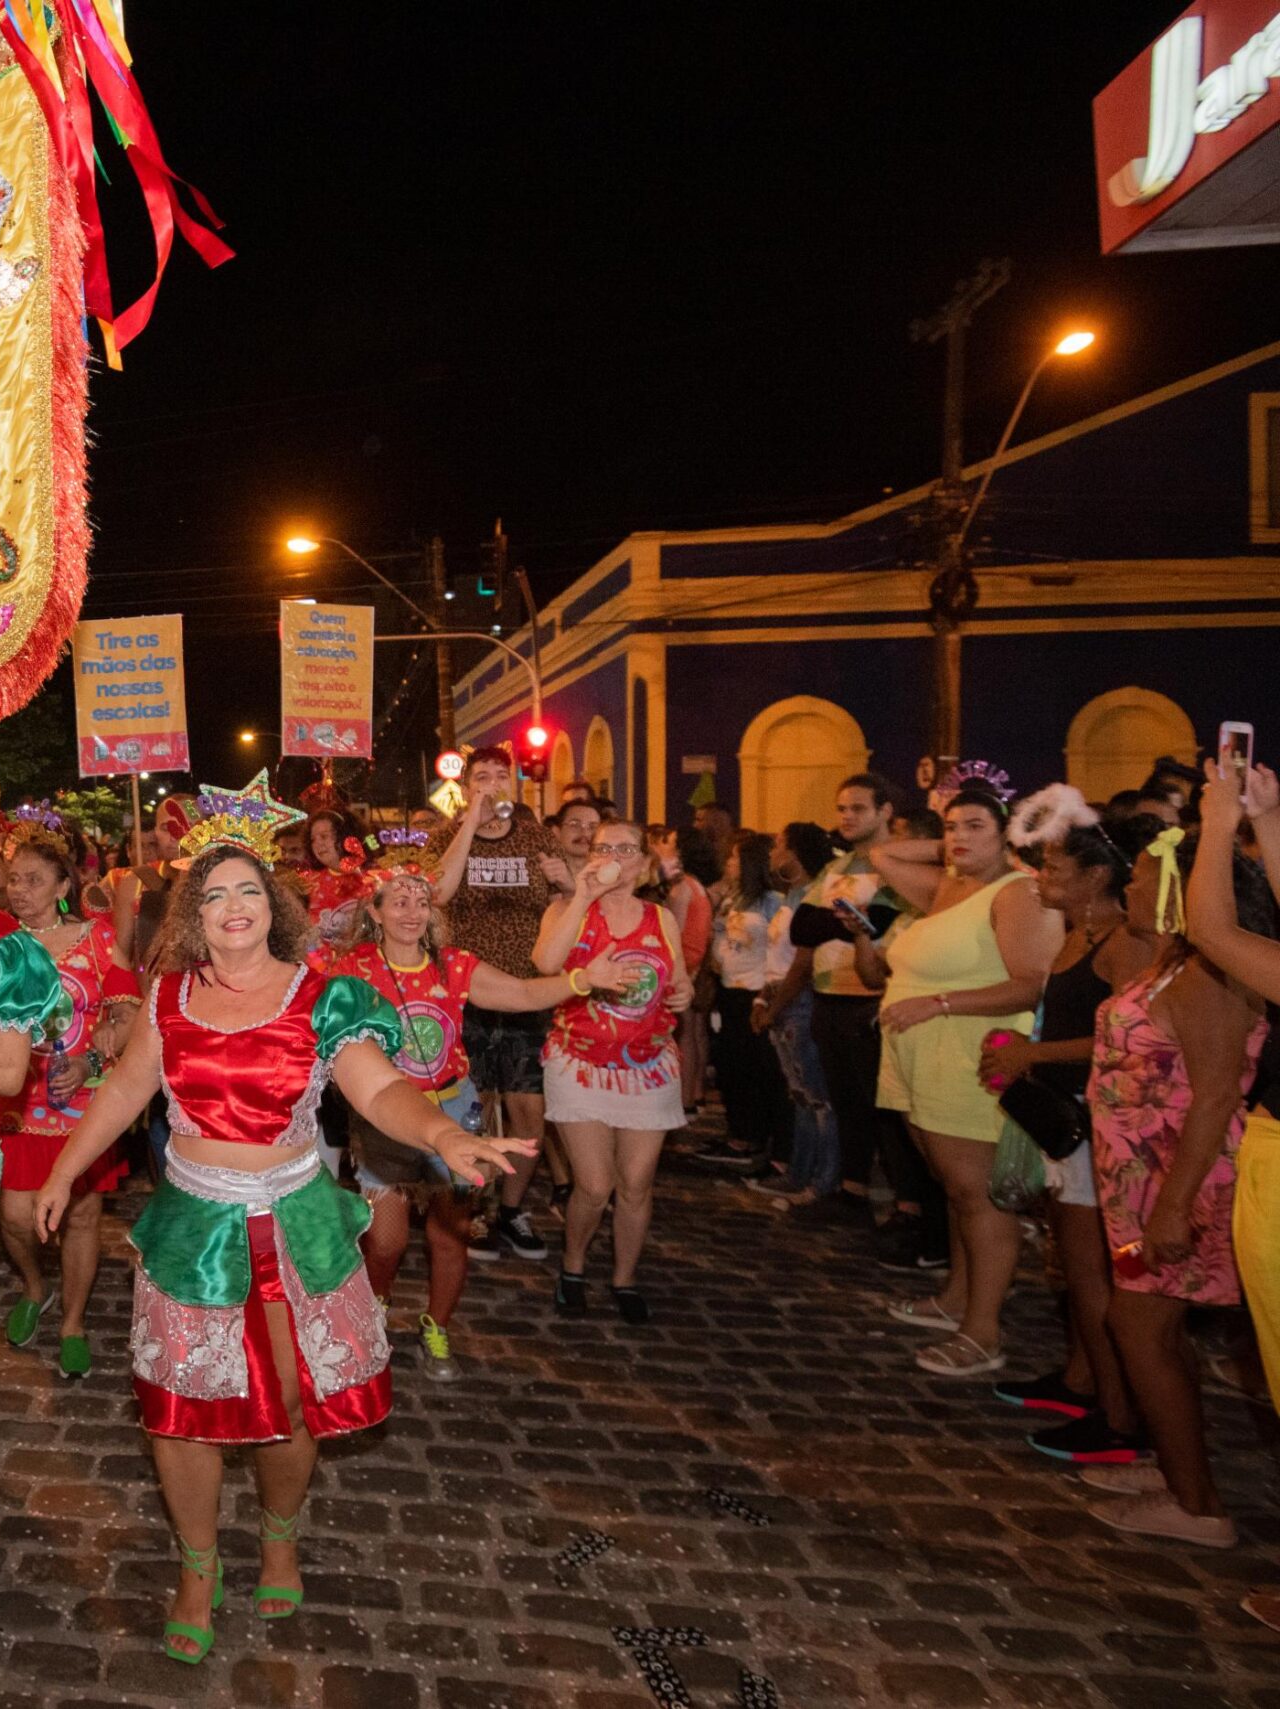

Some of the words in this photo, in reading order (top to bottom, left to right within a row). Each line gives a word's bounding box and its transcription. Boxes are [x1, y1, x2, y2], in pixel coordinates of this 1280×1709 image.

[309, 611, 347, 625] Quem
[95, 632, 133, 651] Tire
[135, 633, 160, 649] as
[81, 655, 137, 675] mãos
[139, 653, 177, 672] das
[304, 663, 350, 676] merece
[96, 680, 165, 698] nossas
[91, 701, 171, 722] escolas!
[442, 758, 460, 770] 30
